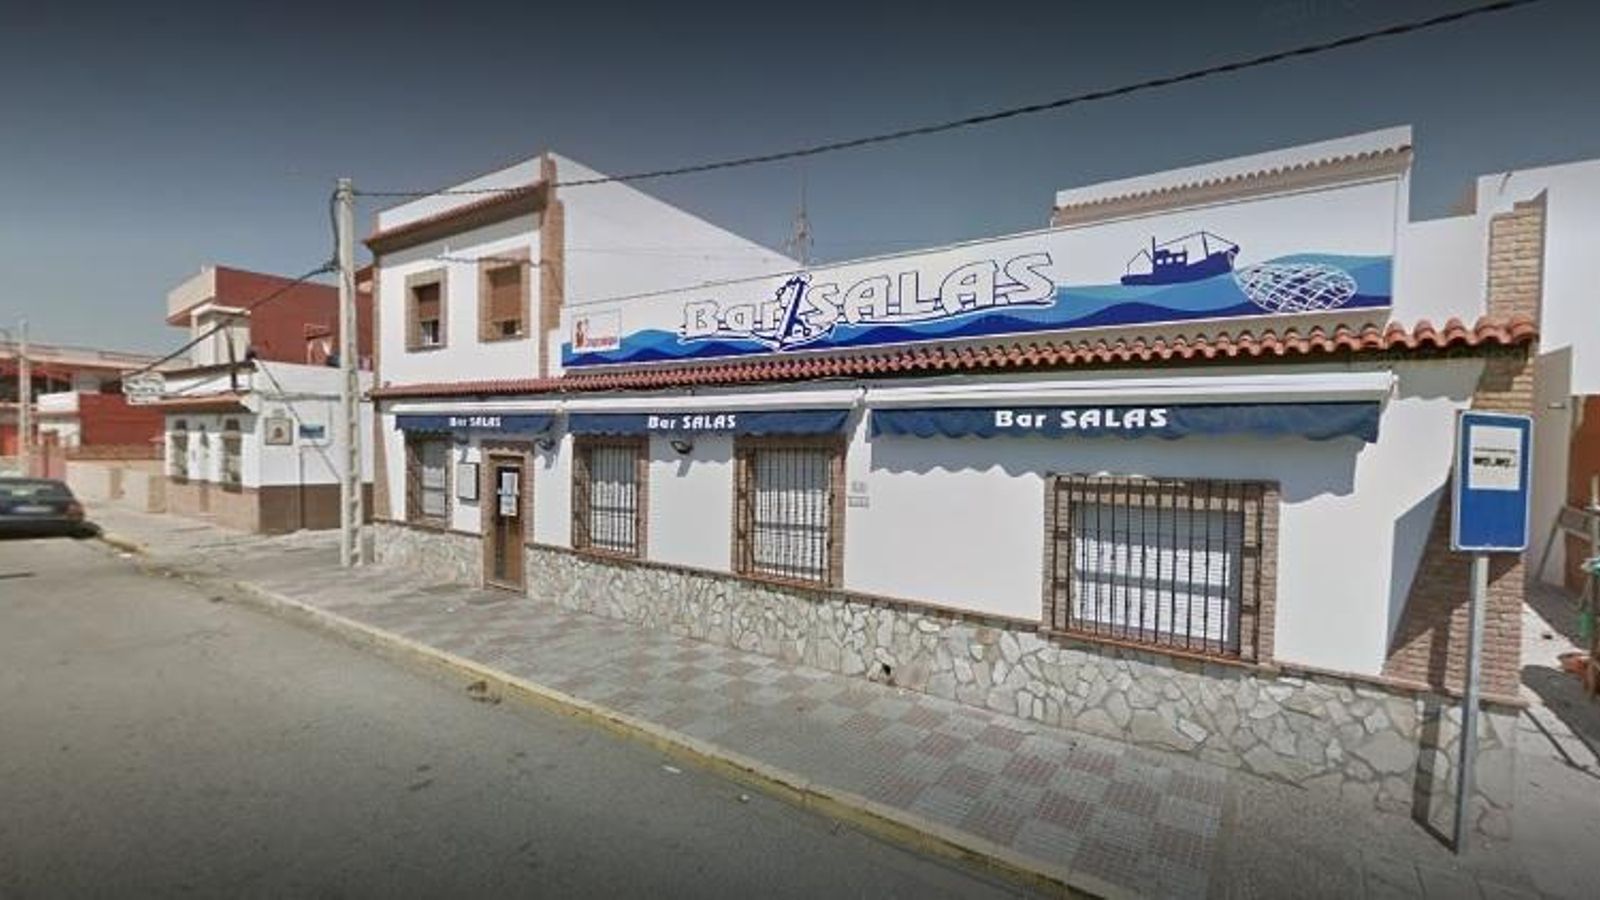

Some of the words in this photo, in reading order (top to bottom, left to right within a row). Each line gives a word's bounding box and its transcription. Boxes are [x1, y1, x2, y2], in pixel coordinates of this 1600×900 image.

[681, 298, 790, 339] Bar
[805, 251, 1055, 329] SALAS
[469, 416, 501, 427] SALAS
[648, 416, 676, 429] Bar
[682, 415, 736, 429] SALAS
[995, 409, 1047, 427] Bar
[1060, 408, 1167, 429] SALAS
